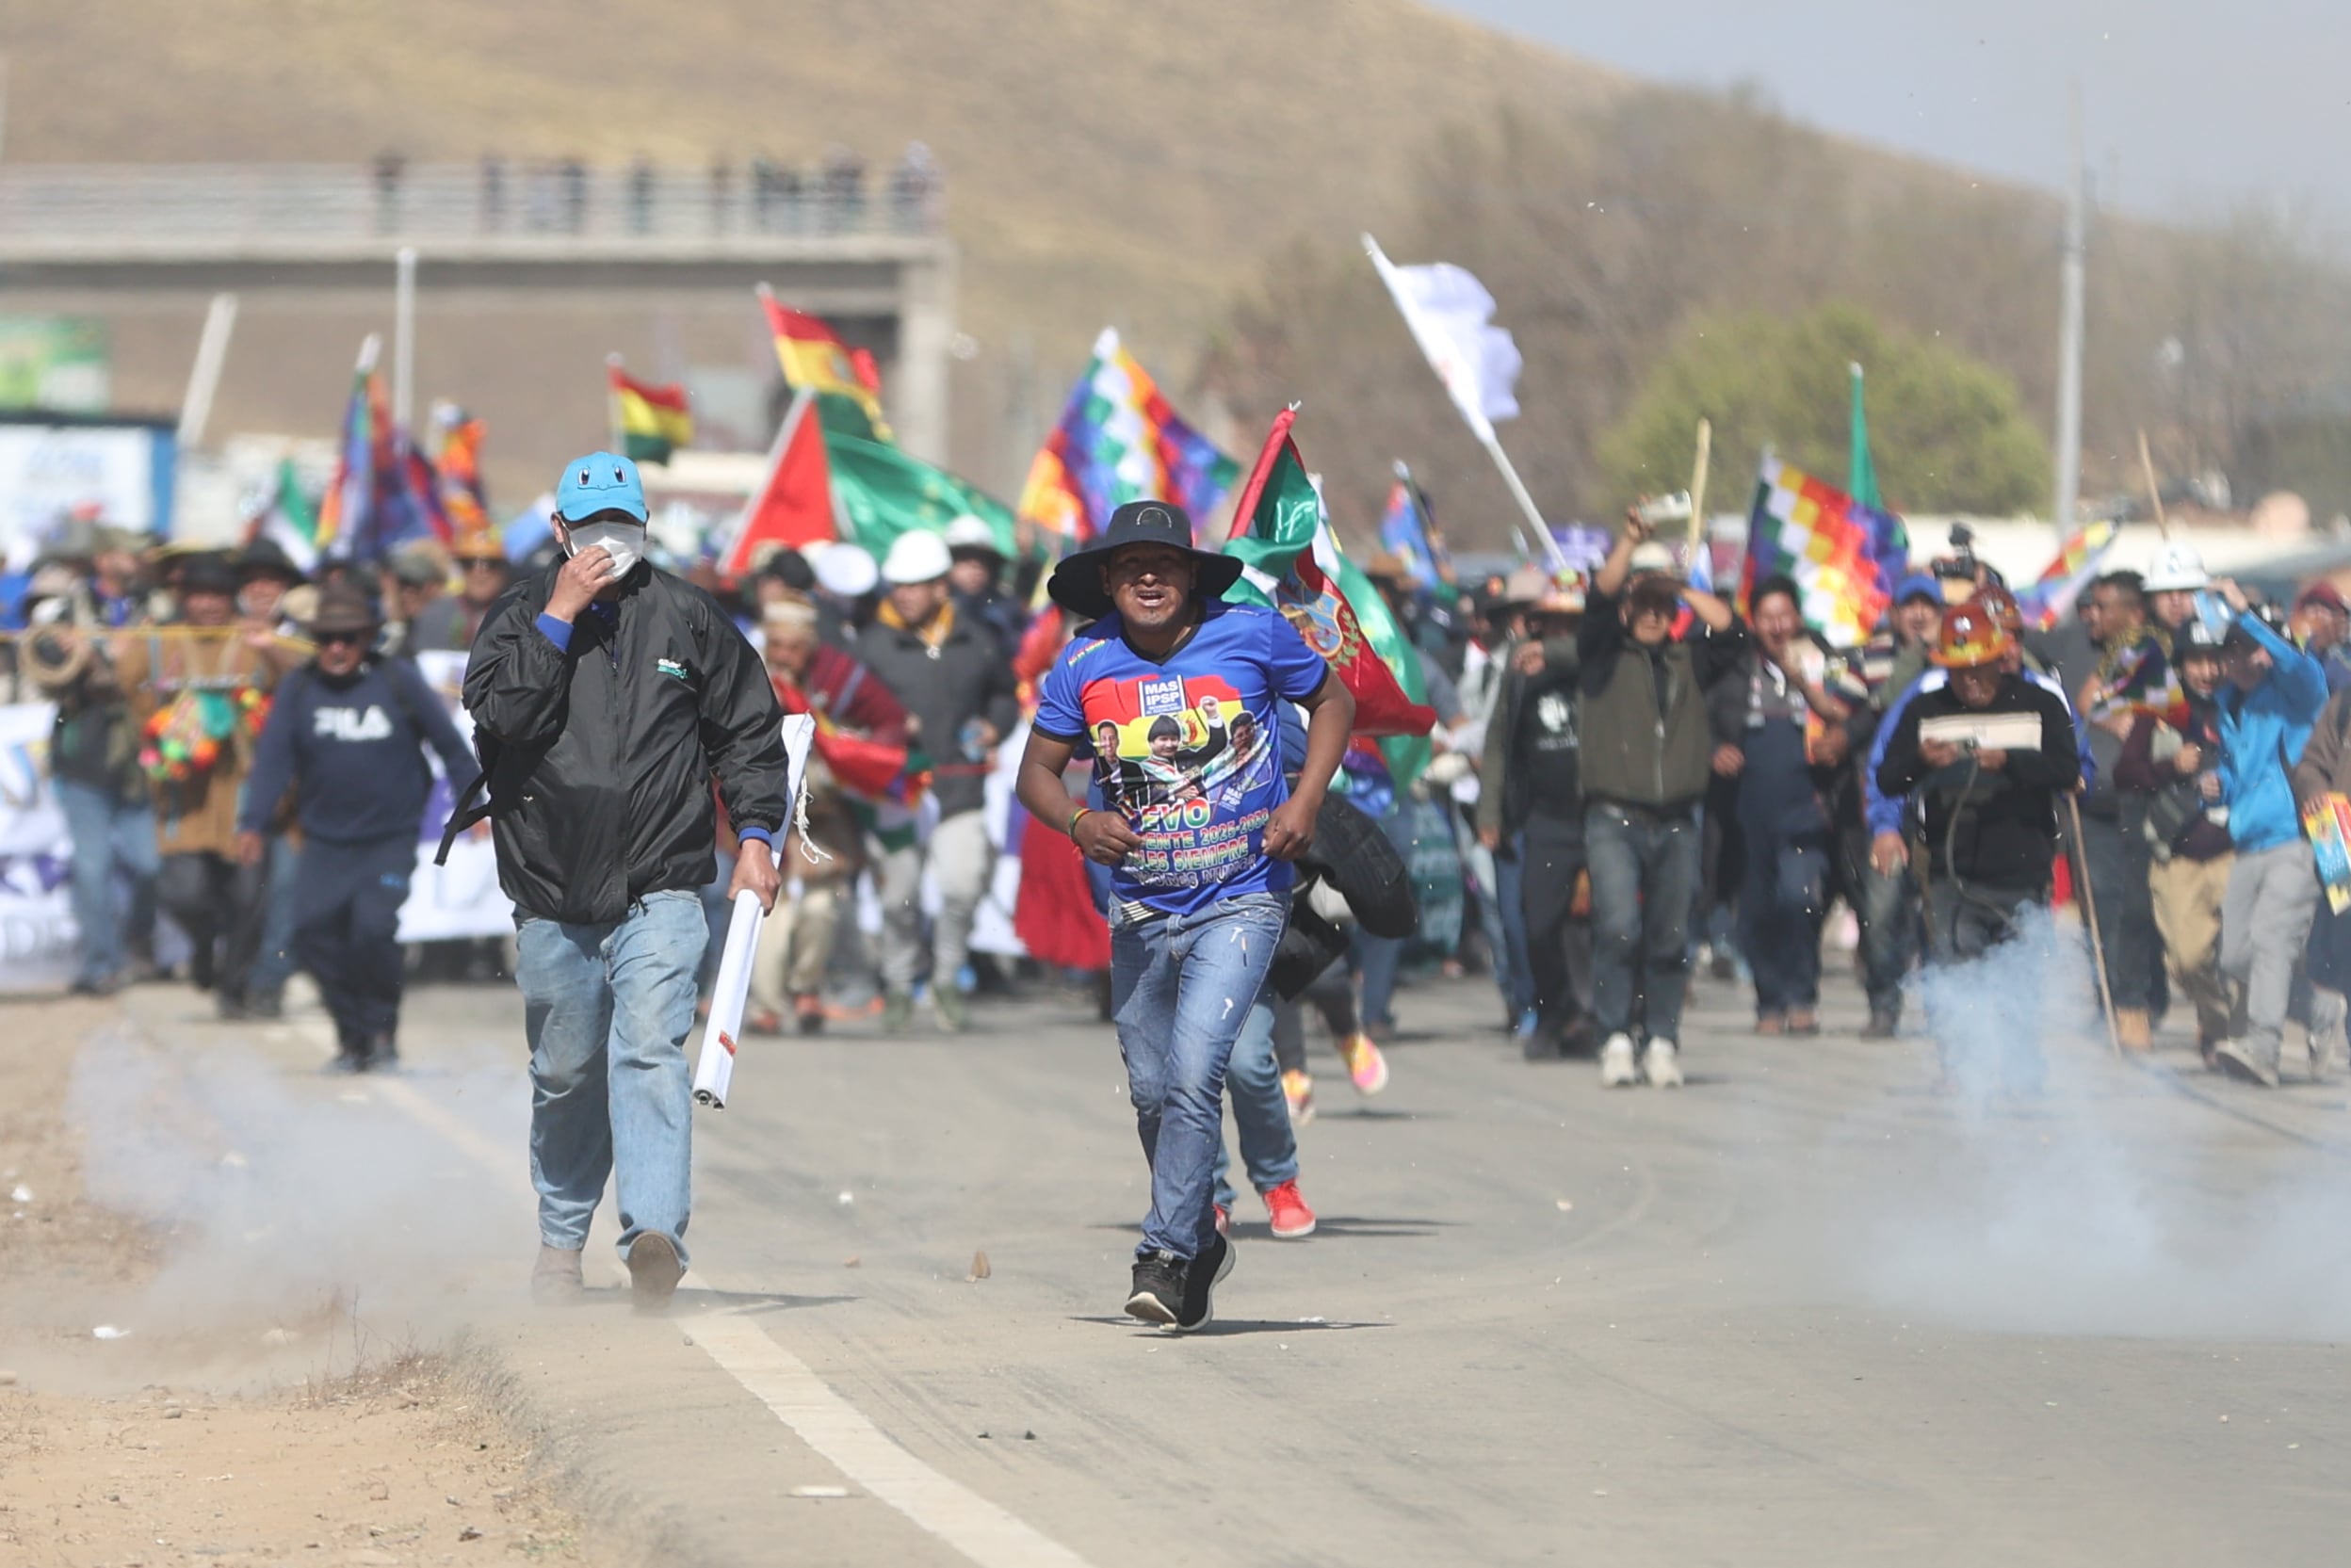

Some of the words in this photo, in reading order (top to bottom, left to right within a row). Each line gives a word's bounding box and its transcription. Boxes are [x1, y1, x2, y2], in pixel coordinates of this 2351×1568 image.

[1144, 681, 1178, 695] MAS
[1145, 692, 1179, 705] IPSP
[314, 704, 393, 741] FILA
[1142, 797, 1210, 832] EVO
[1172, 834, 1249, 872] SIEMPRE
